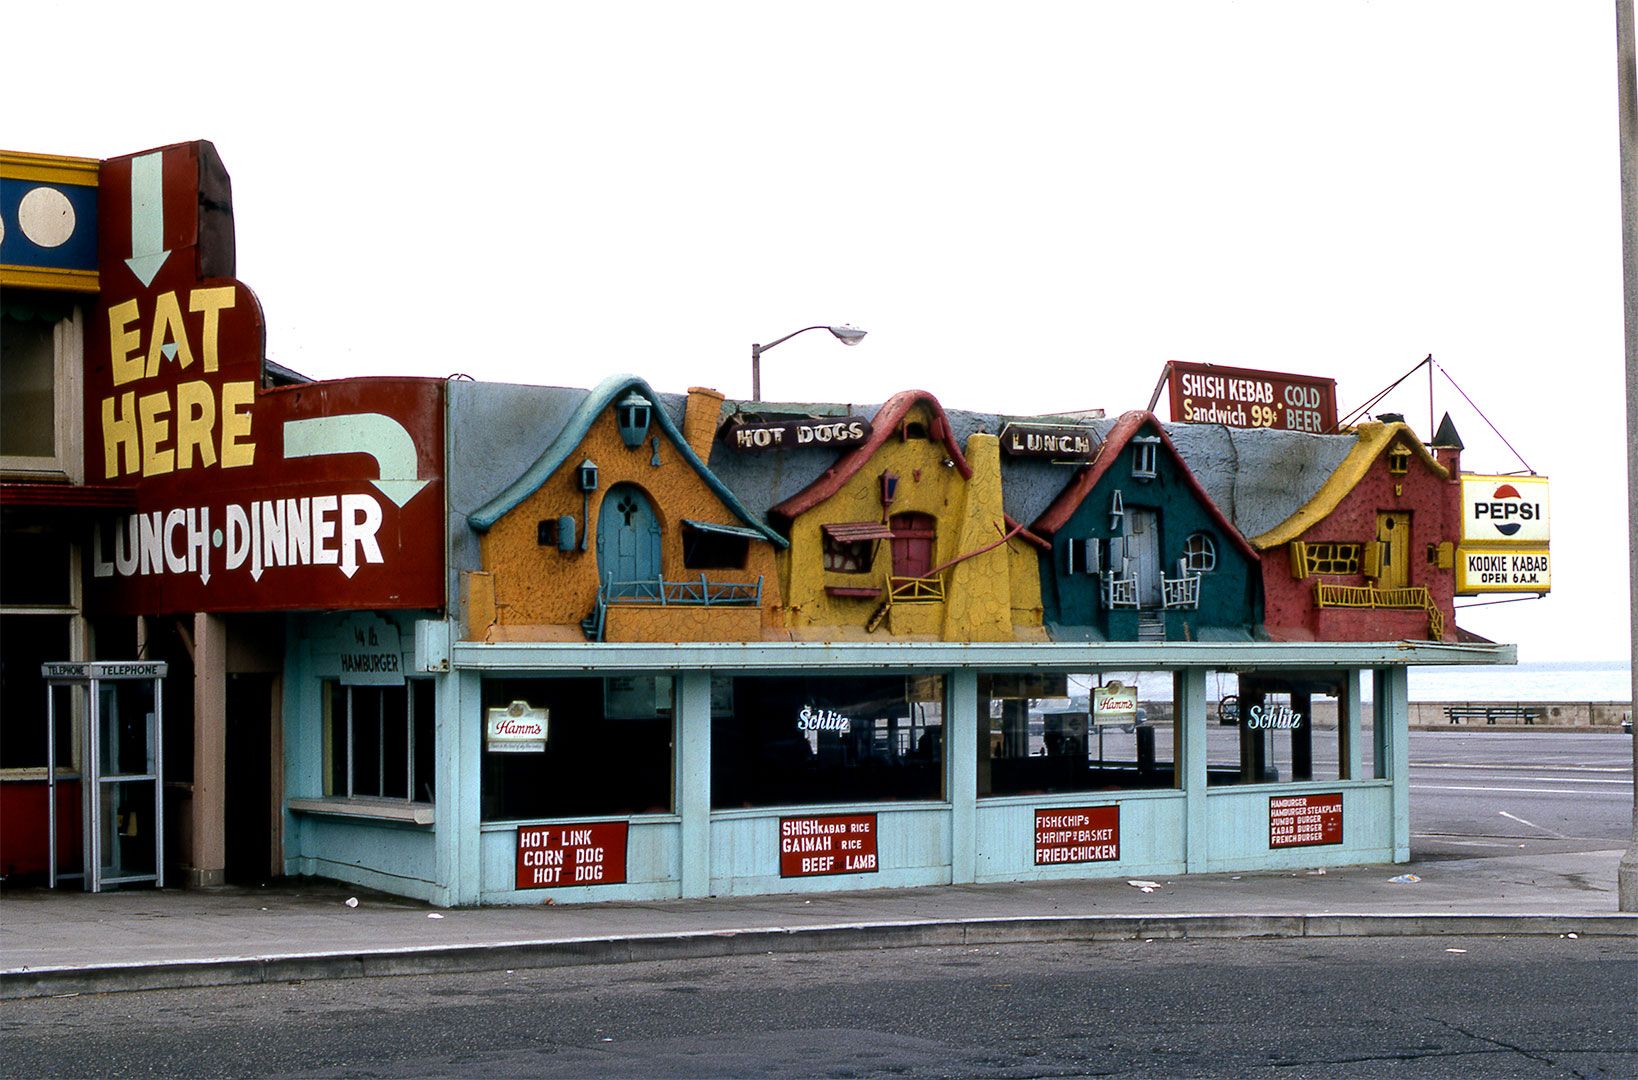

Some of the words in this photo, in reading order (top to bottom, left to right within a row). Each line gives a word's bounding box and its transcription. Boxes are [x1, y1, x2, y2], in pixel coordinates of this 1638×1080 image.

[108, 286, 236, 386] EAT
[1182, 373, 1225, 400] SHISH
[1228, 379, 1274, 404] KEBAB
[1284, 385, 1320, 409] COLD
[1183, 398, 1247, 426] Sandwich
[1286, 408, 1322, 432] BEER
[102, 380, 256, 479] HERE
[736, 428, 785, 448] HOT
[797, 422, 864, 443] DOGS
[1012, 433, 1090, 453] LUNCH
[1474, 502, 1540, 520] PEPSI
[226, 493, 384, 582] DINNER
[1469, 556, 1507, 572] KOOKIE
[1512, 556, 1548, 572] KABAB
[1481, 573, 1508, 583] OPEN
[47, 665, 85, 676] TELEPHONE
[101, 665, 158, 676] TELEPHONE
[341, 653, 399, 672] HAMBURGER
[494, 719, 543, 735] Hamm's
[797, 709, 849, 730] Schlitz
[1247, 705, 1302, 730] Schlitz
[850, 823, 870, 833] RICE
[1078, 828, 1113, 842] BASKET
[521, 831, 550, 848] HOT
[561, 829, 592, 846] LINK
[783, 836, 832, 853] GAIMAH
[841, 840, 862, 850] RICE
[524, 850, 564, 867] CORN
[576, 847, 604, 864] DOG
[802, 856, 835, 872] BEEF
[846, 854, 876, 870] LAMB
[533, 867, 562, 883] HOT
[575, 865, 603, 881] DOG
